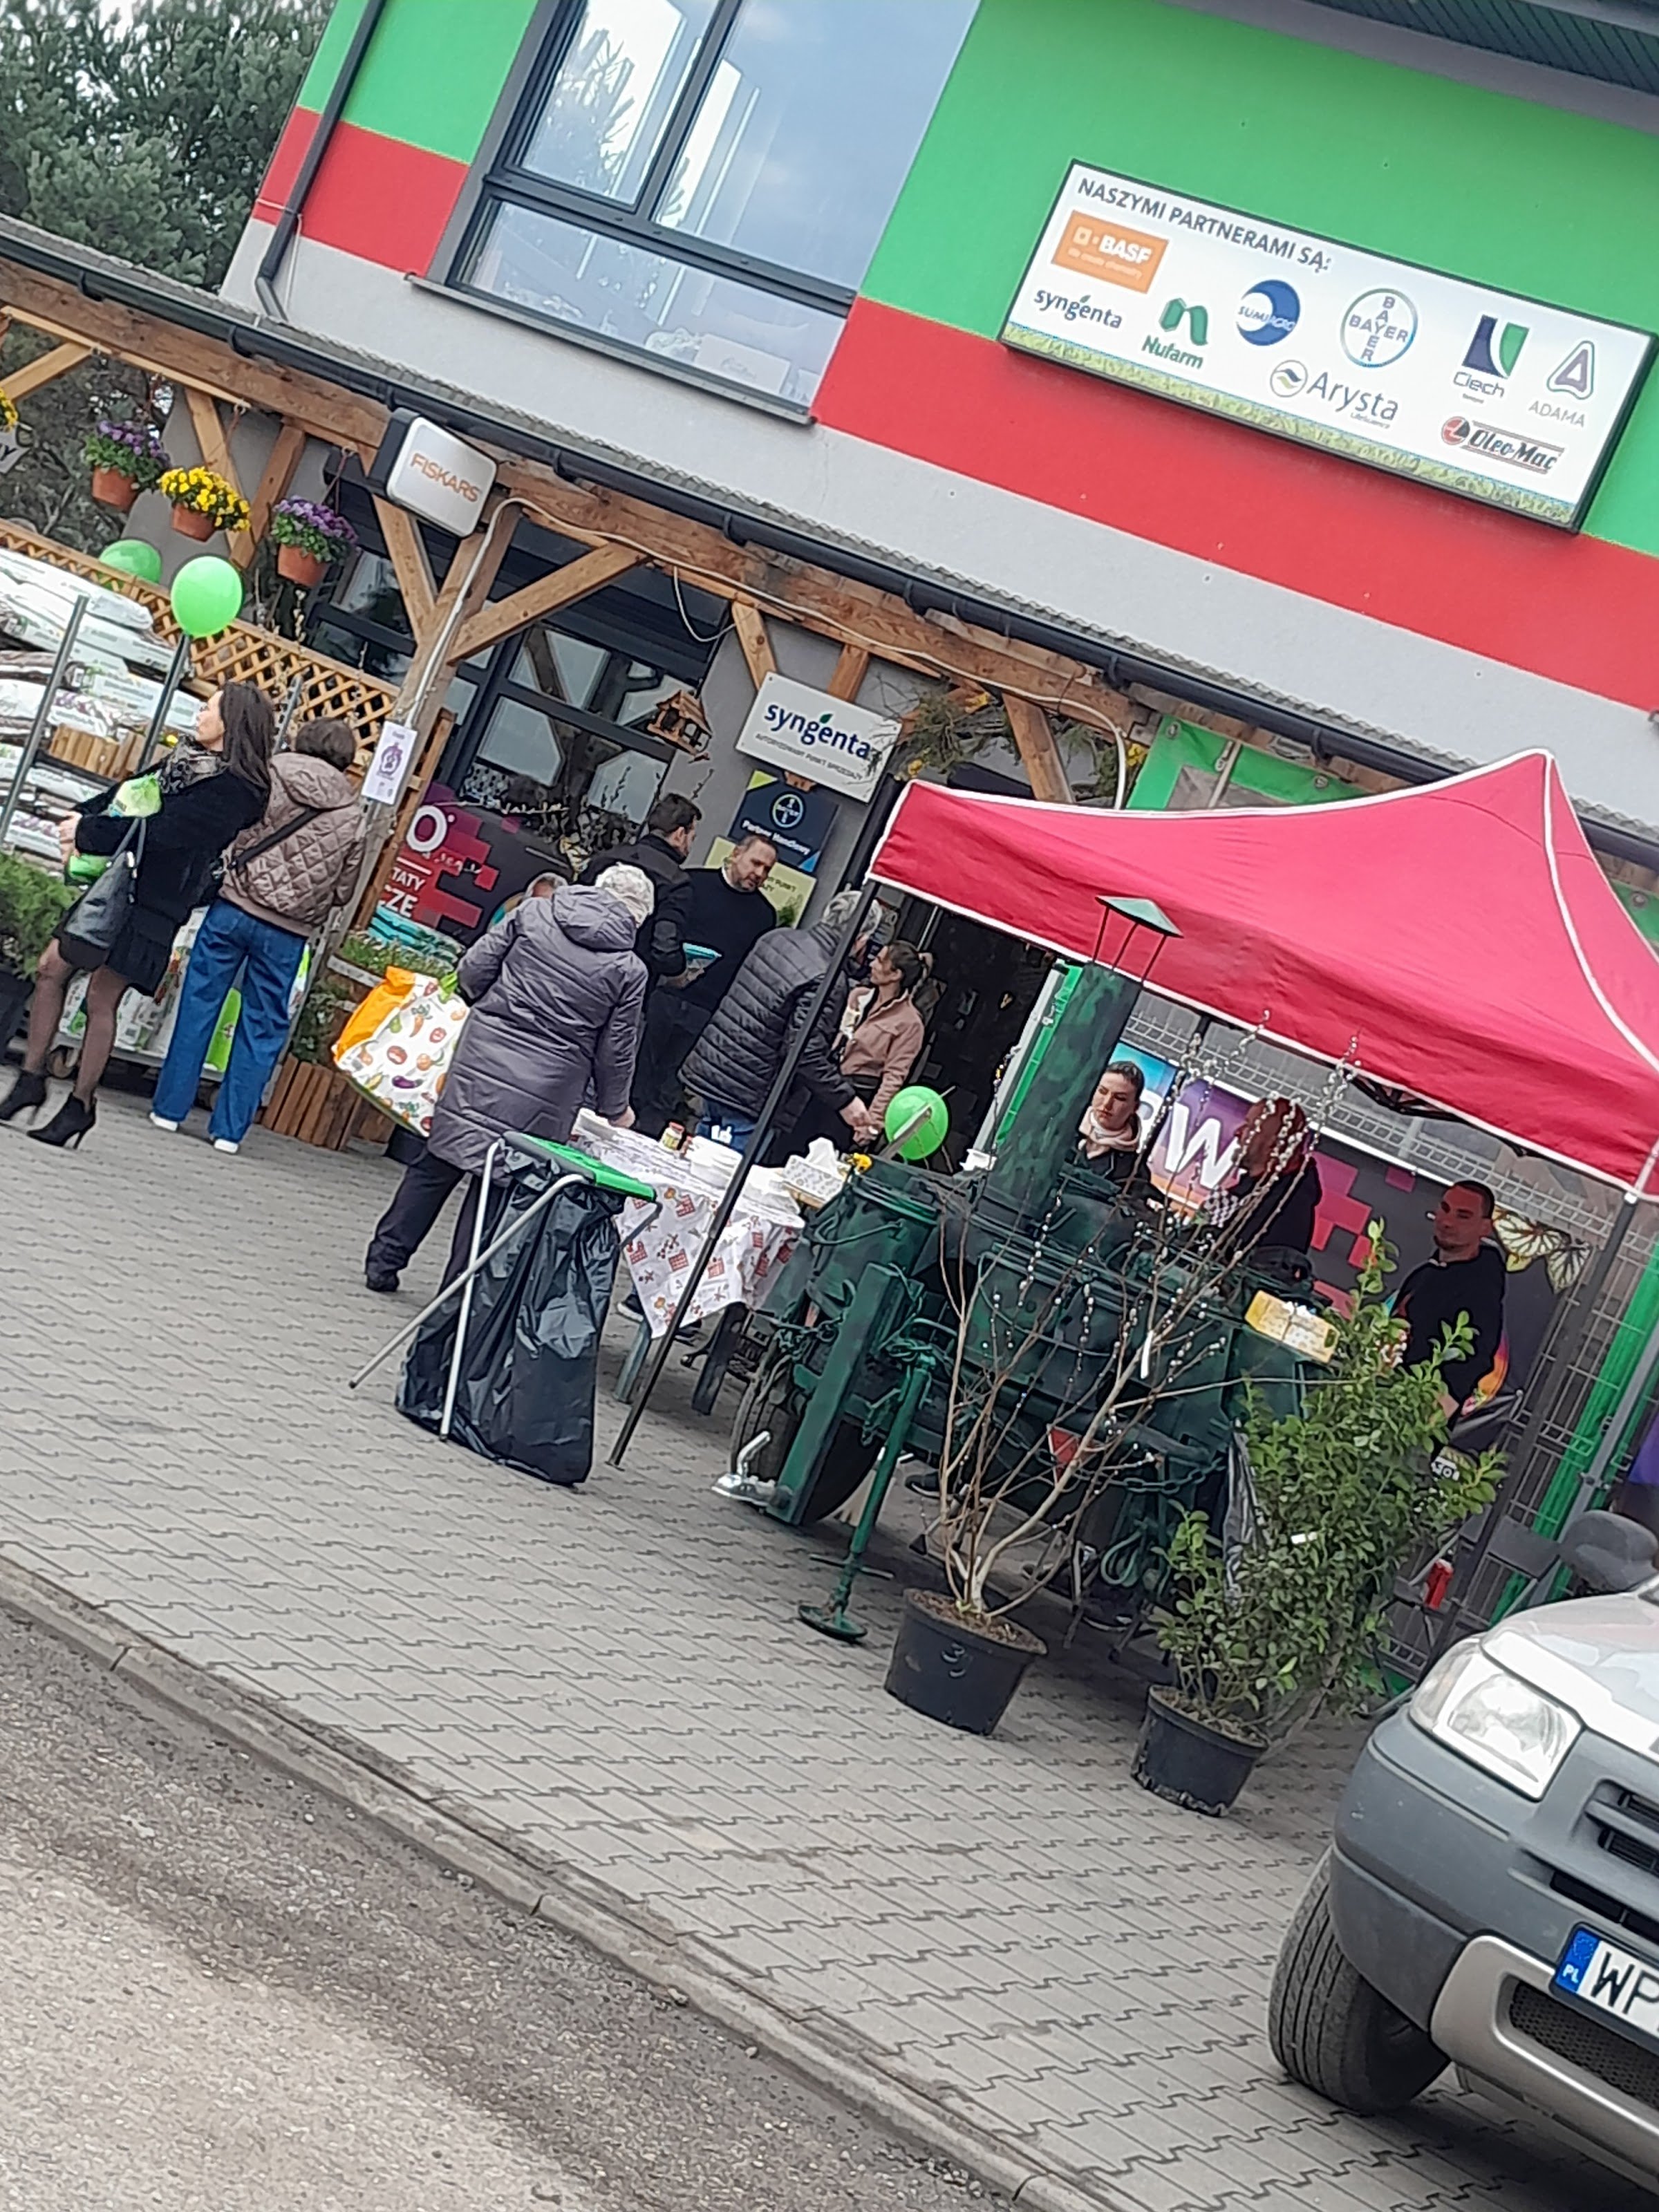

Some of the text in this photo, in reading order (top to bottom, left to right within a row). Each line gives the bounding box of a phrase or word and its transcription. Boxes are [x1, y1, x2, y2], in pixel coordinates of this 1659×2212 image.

[1078, 178, 1331, 273] NASZYMI PARTNERAMI SĄ:
[1098, 234, 1152, 263] BASF
[1034, 289, 1123, 329] syngenta
[1349, 314, 1409, 343] BAYER
[1360, 296, 1396, 362] BAYER
[1141, 335, 1204, 370] Nufarm
[1306, 371, 1398, 421] Arysta
[1453, 371, 1506, 398] Ciech
[1528, 400, 1586, 428] ADAMA
[410, 452, 483, 503] FISKARS
[764, 704, 871, 760] syngenta
[1562, 1963, 1579, 1984] PL
[1591, 1951, 1659, 2031] WP
